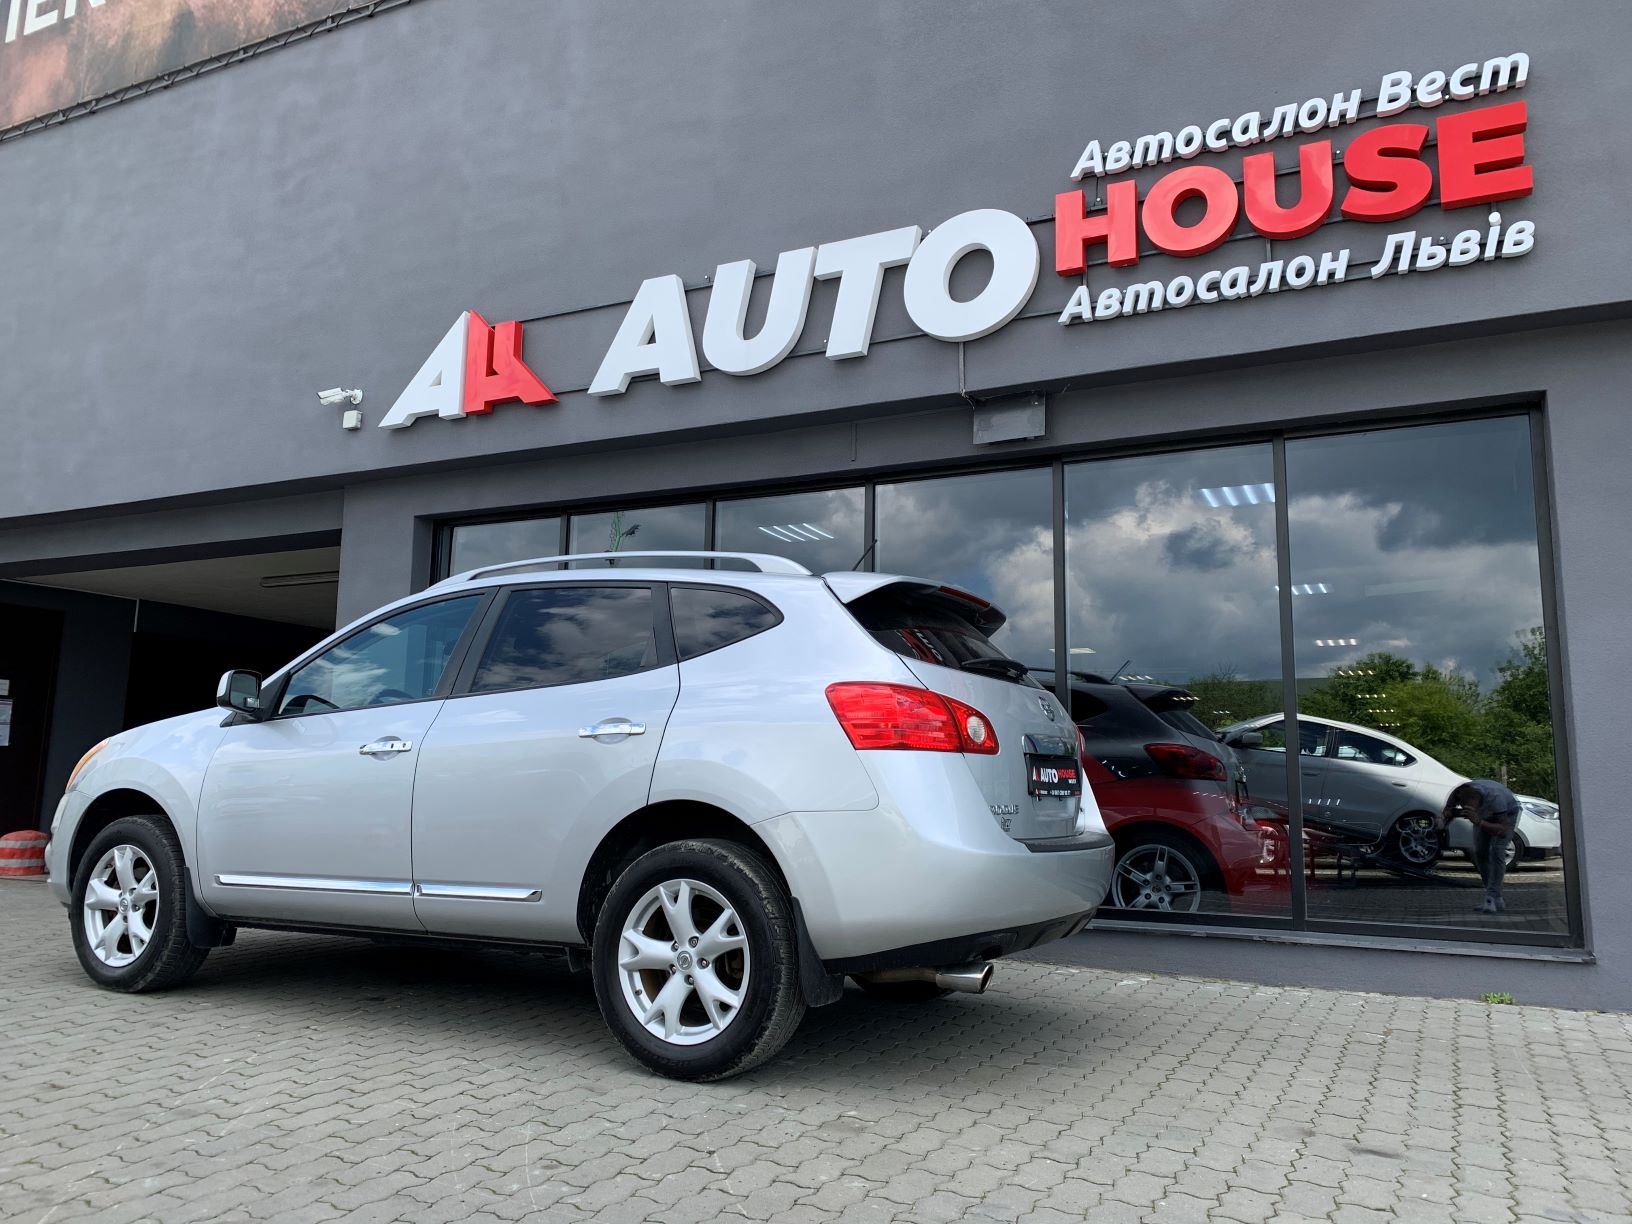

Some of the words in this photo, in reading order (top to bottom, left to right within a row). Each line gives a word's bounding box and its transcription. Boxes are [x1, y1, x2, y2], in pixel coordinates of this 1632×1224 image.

[1071, 88, 1363, 182] Автосалон
[1377, 53, 1530, 118] Вест
[588, 208, 1040, 397] AUTO
[1055, 101, 1534, 276] HOUSE
[1058, 248, 1350, 325] Автосалон
[1371, 211, 1536, 279] Львів
[1040, 767, 1059, 783] AUTO
